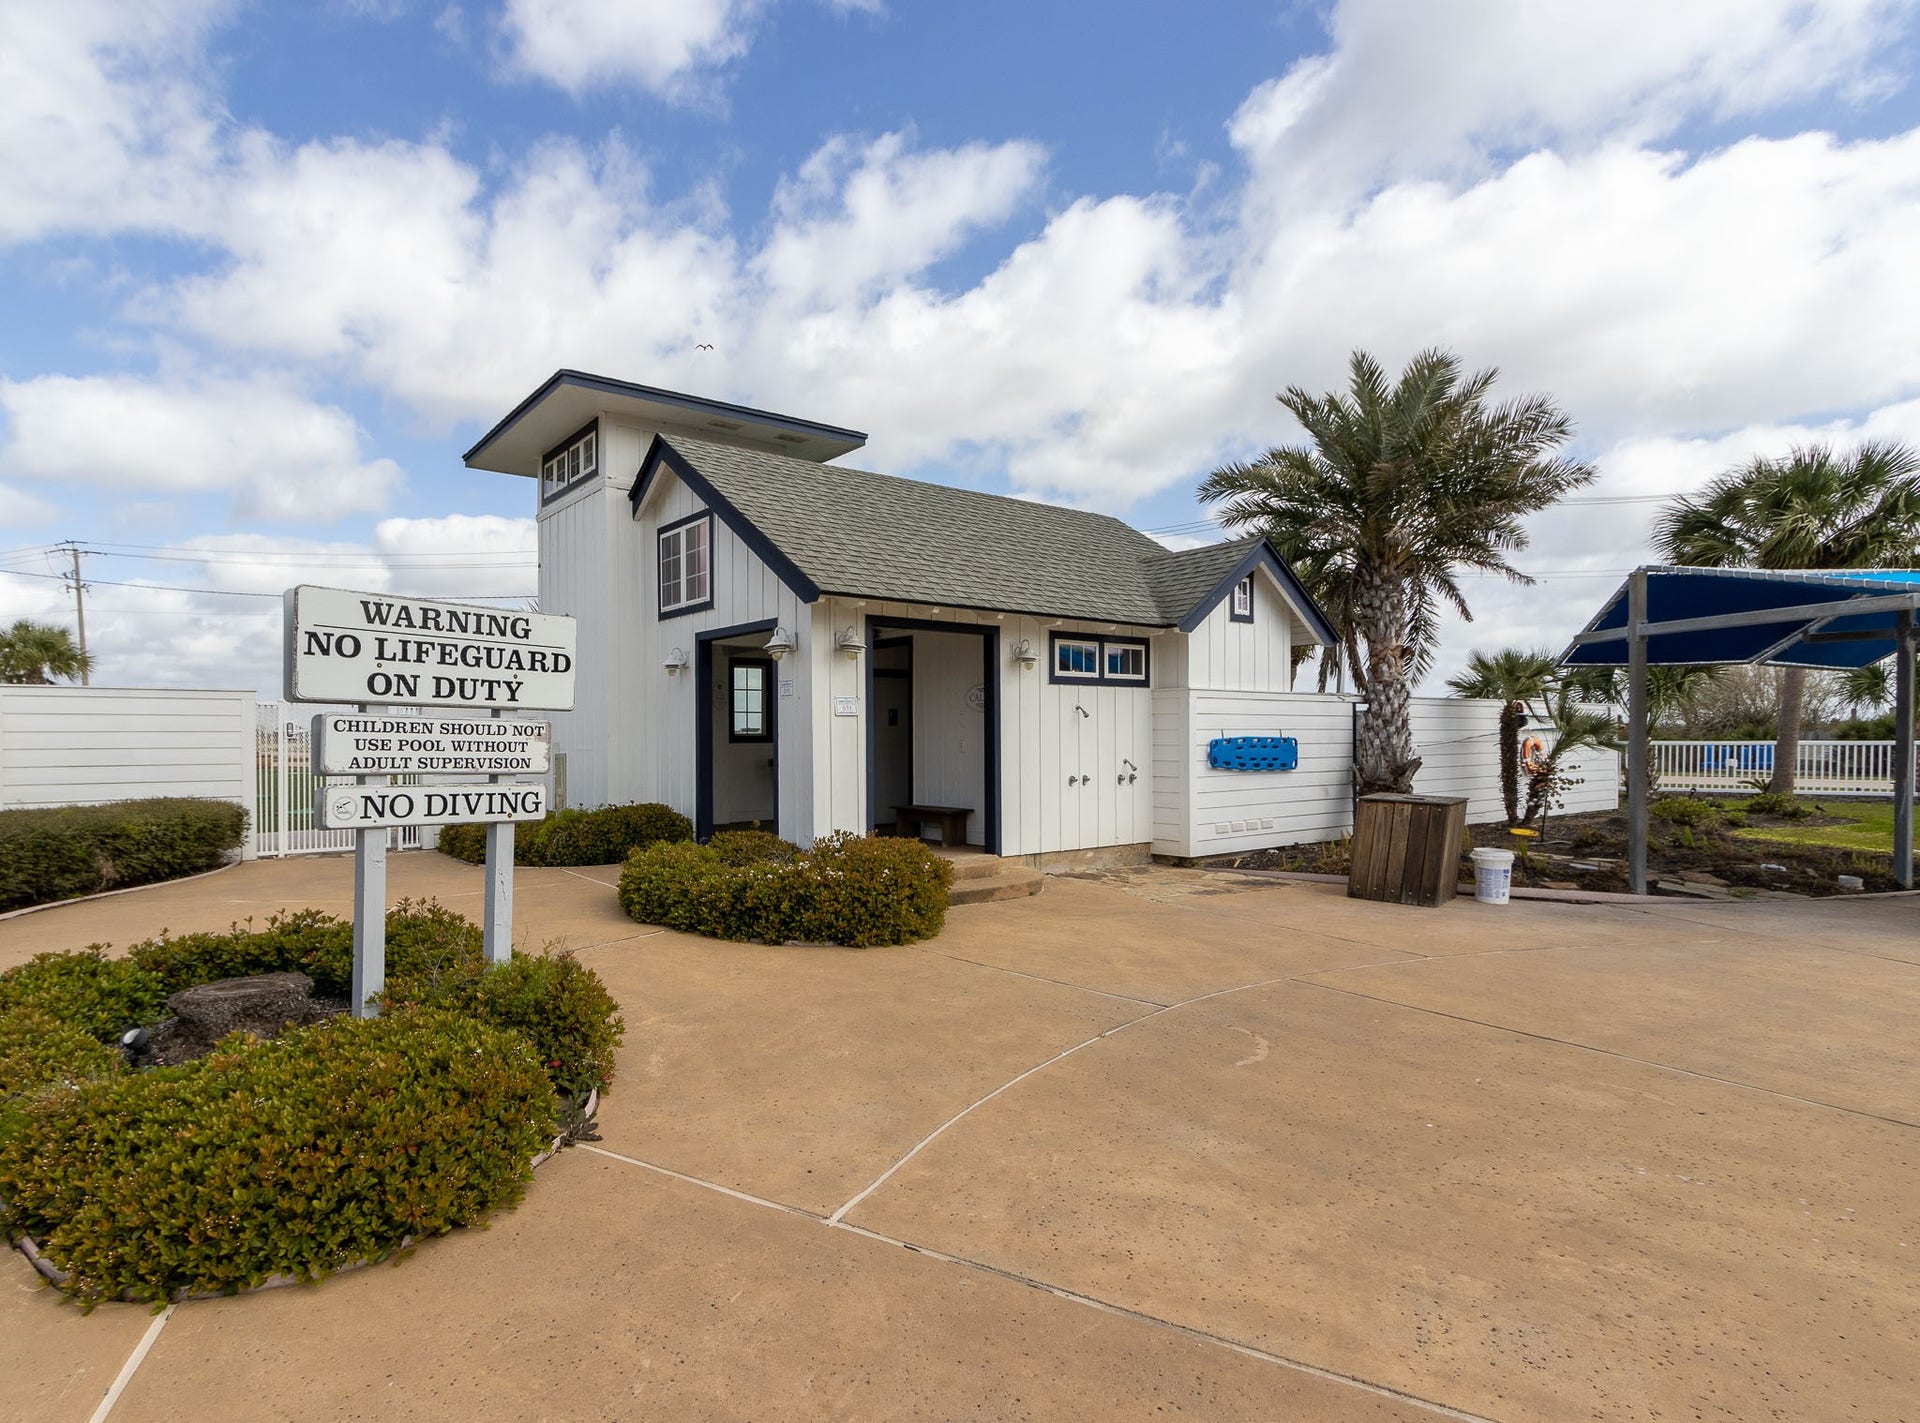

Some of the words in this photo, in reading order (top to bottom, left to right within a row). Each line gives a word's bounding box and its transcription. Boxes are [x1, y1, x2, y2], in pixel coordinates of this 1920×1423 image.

[360, 600, 531, 639] WARNING
[303, 631, 361, 658] NO
[374, 637, 571, 673] LIFEGUARD
[367, 672, 420, 697] ON
[432, 675, 523, 702] DUTY
[333, 719, 434, 735] CHILDREN
[439, 723, 507, 736] SHOULD
[512, 725, 544, 737] NOT
[354, 738, 391, 751] USE
[397, 739, 446, 752] POOL
[452, 741, 528, 753] WITHOUT
[348, 757, 411, 769] ADULT
[417, 757, 531, 769] SUPERVISION
[359, 794, 414, 819] NO
[423, 791, 542, 817] DIVING
